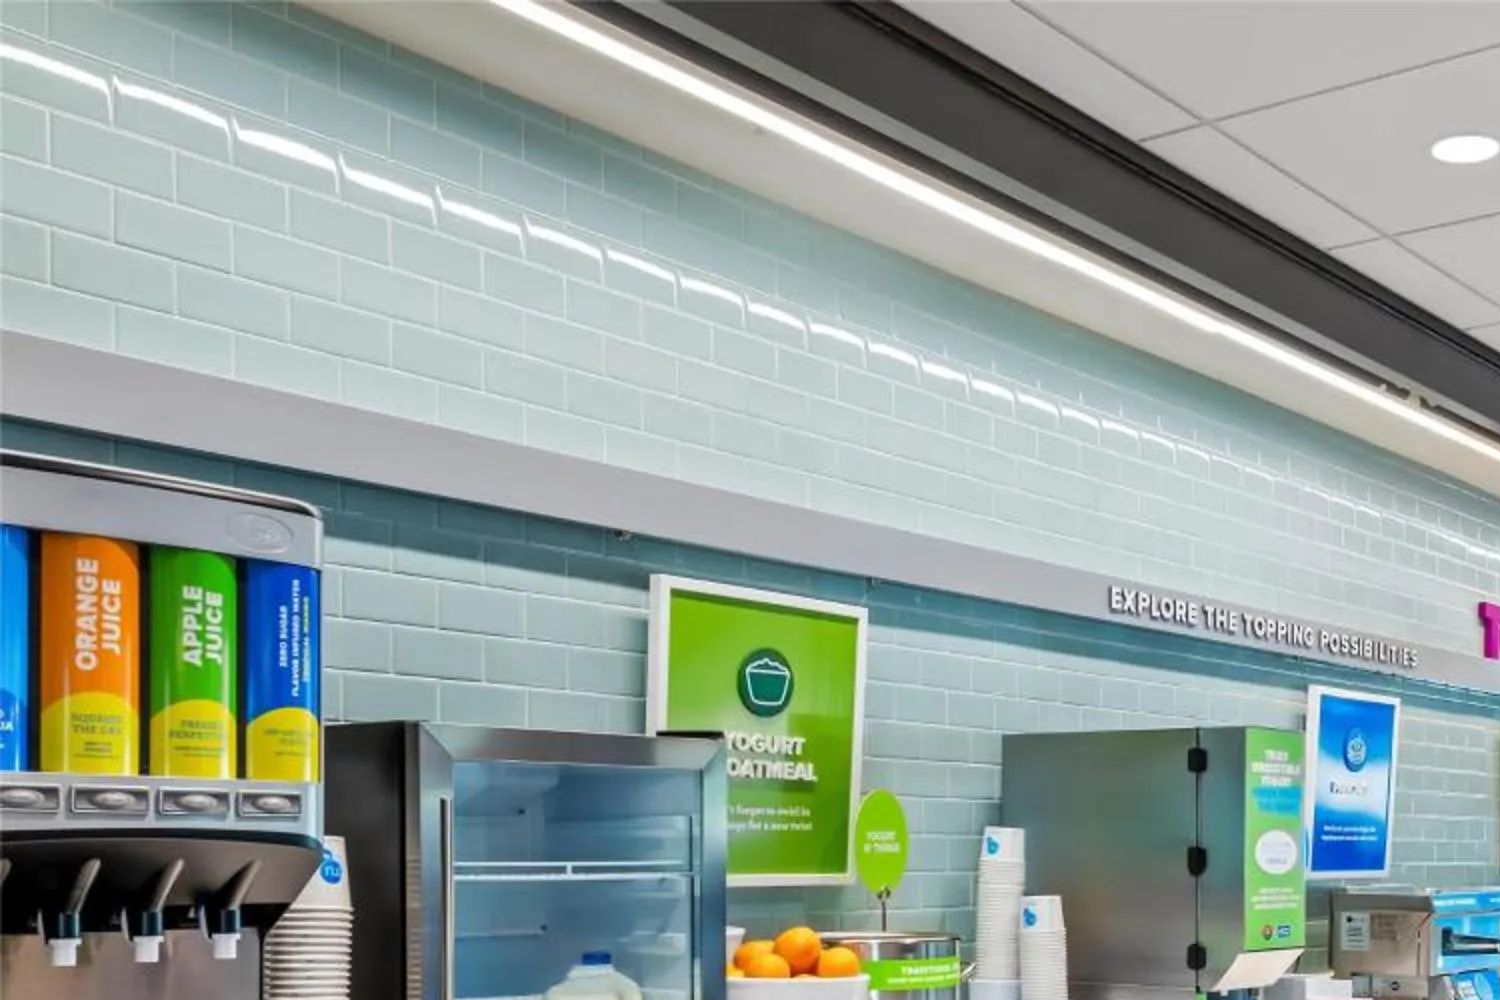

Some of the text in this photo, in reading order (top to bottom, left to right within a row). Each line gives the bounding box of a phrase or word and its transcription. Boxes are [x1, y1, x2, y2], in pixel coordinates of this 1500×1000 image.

[75, 558, 99, 671] ORANGE
[102, 579, 121, 655] JUICE
[182, 586, 204, 667] APPLE
[204, 591, 224, 666] JUICE
[1108, 584, 1419, 669] EXPLORE THE TOPPING POSSIBILITIES
[726, 731, 807, 755] YOGURT
[726, 757, 818, 781] OATMEAL
